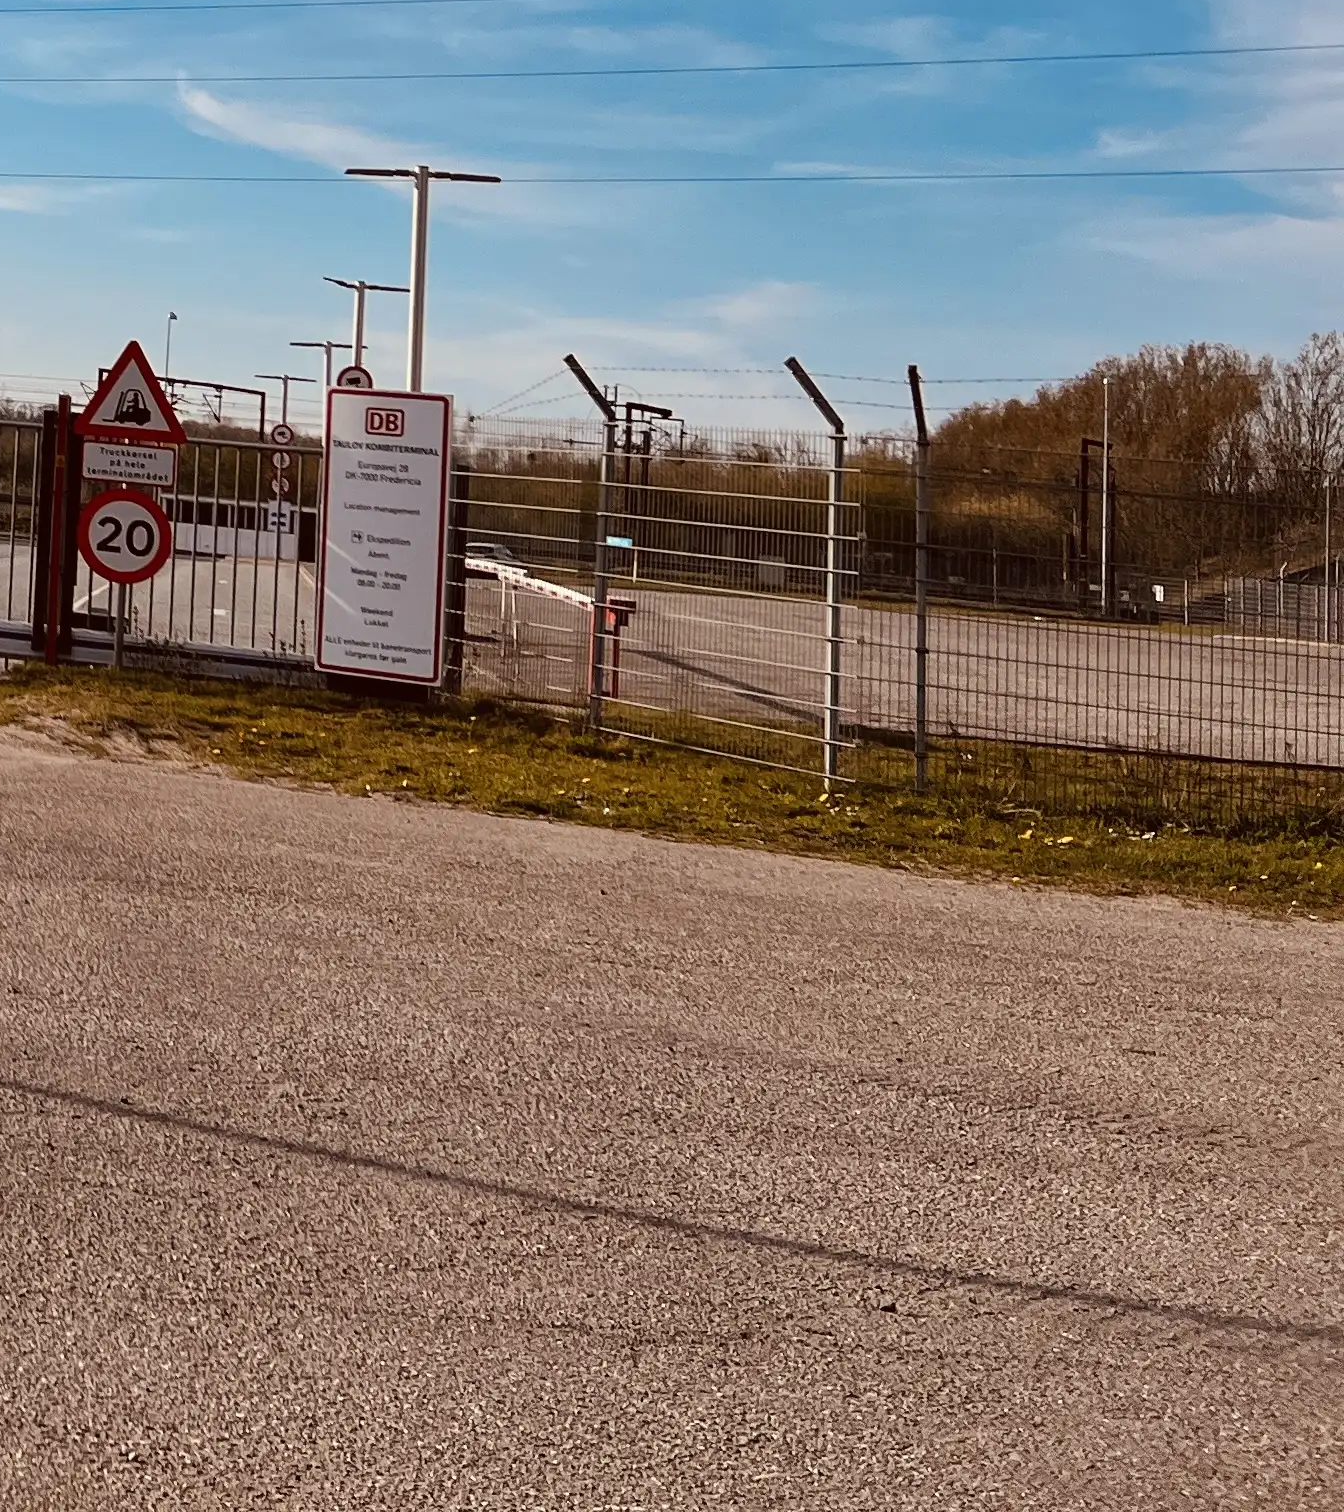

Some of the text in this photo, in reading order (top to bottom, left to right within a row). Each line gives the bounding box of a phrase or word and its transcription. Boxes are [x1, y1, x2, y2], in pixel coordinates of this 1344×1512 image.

[369, 412, 400, 432] DB
[365, 443, 440, 457] KOMBITERMINAL
[109, 458, 146, 469] på hele
[86, 466, 169, 483] terminalområdet
[379, 474, 422, 486] Fredericia
[96, 516, 155, 557] 20
